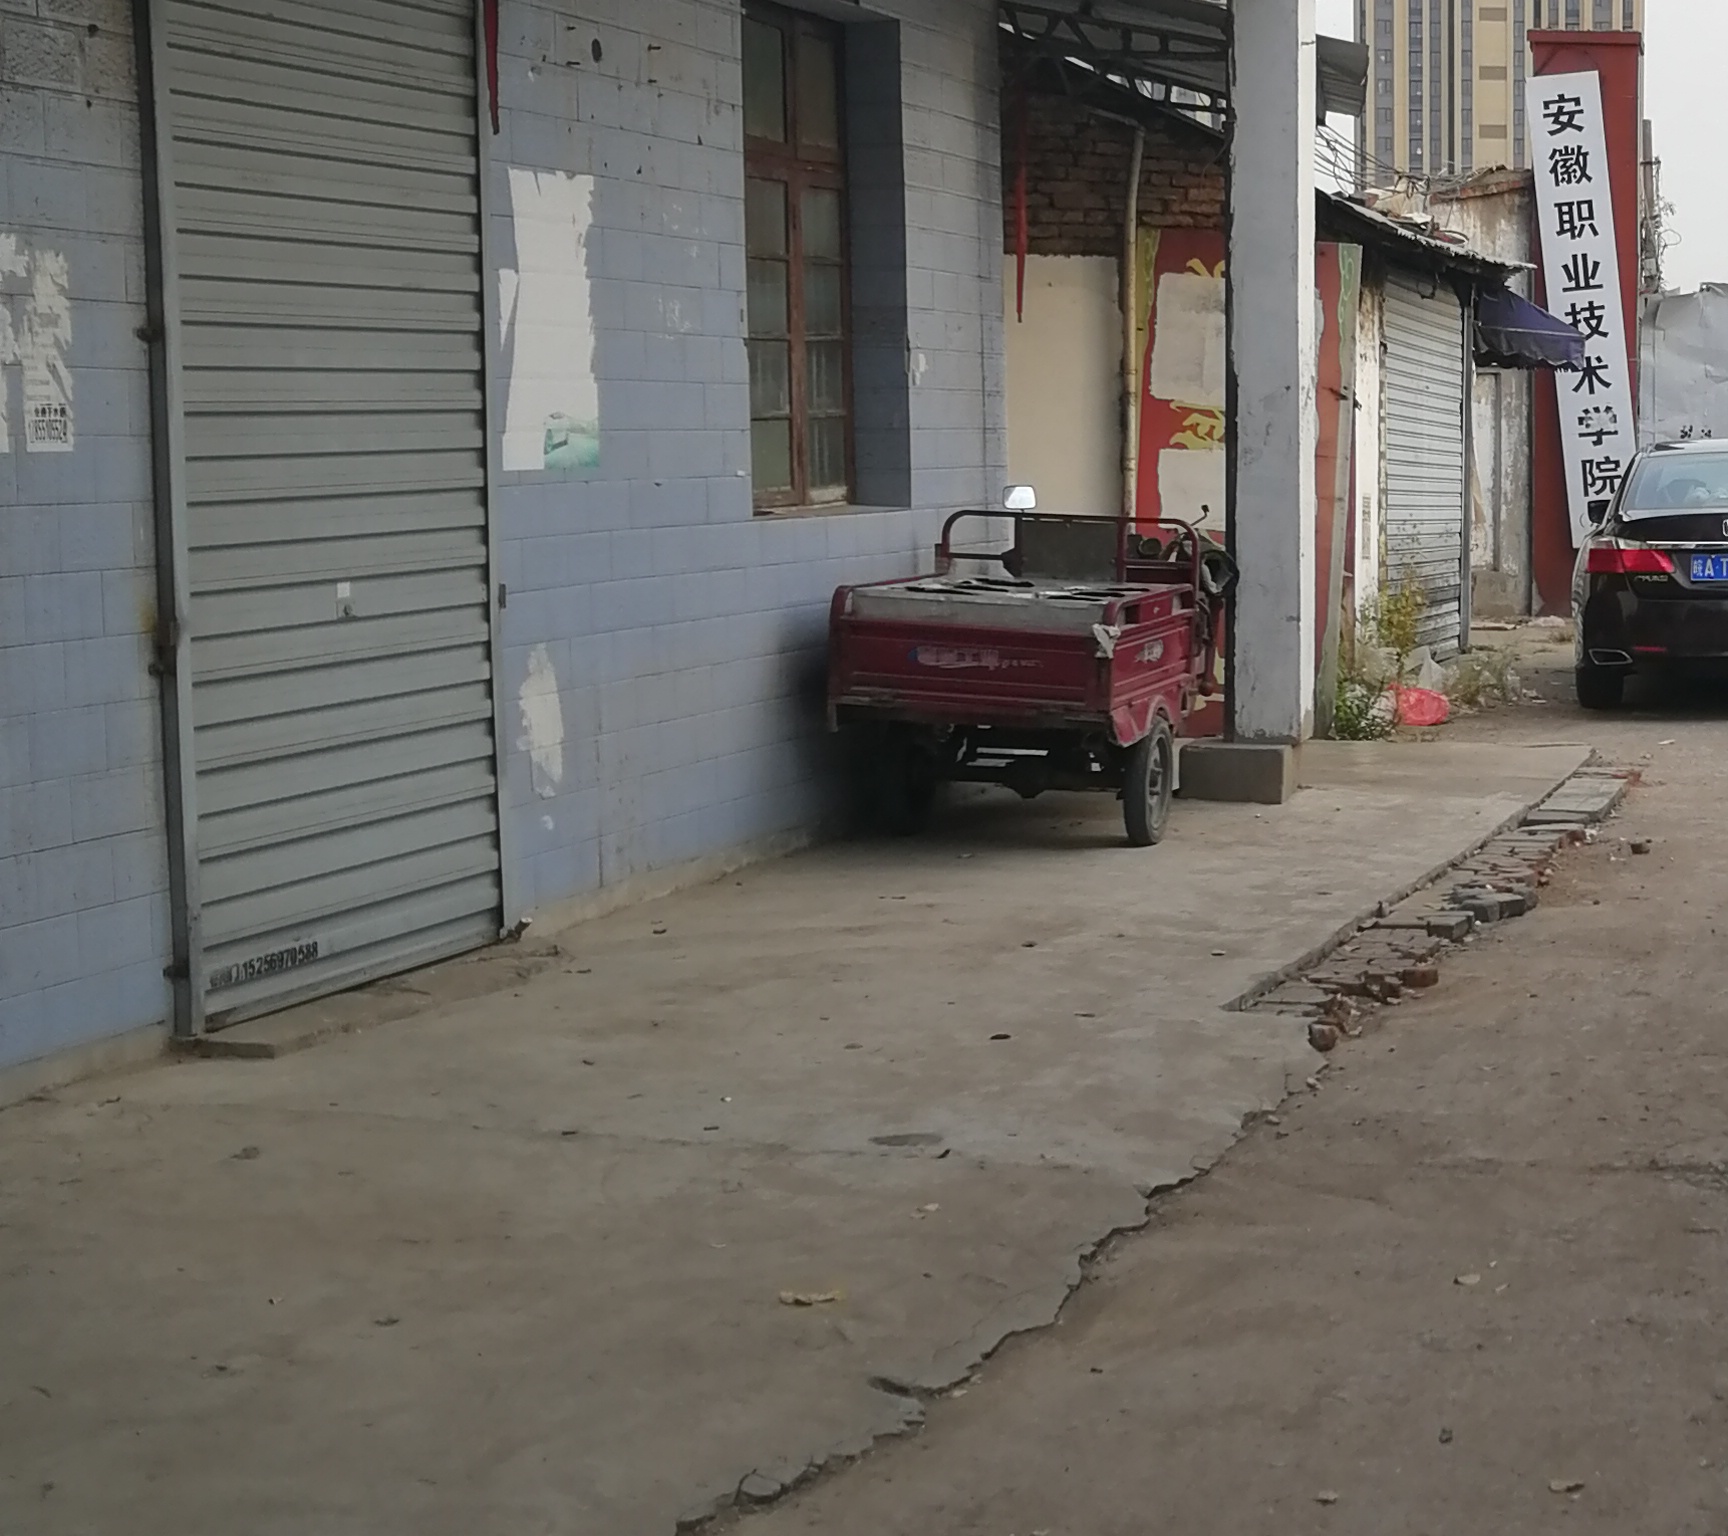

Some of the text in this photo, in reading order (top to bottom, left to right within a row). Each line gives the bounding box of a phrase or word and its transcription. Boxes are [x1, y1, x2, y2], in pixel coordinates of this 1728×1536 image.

[1542, 94, 1622, 497] 安徽职业技术学院
